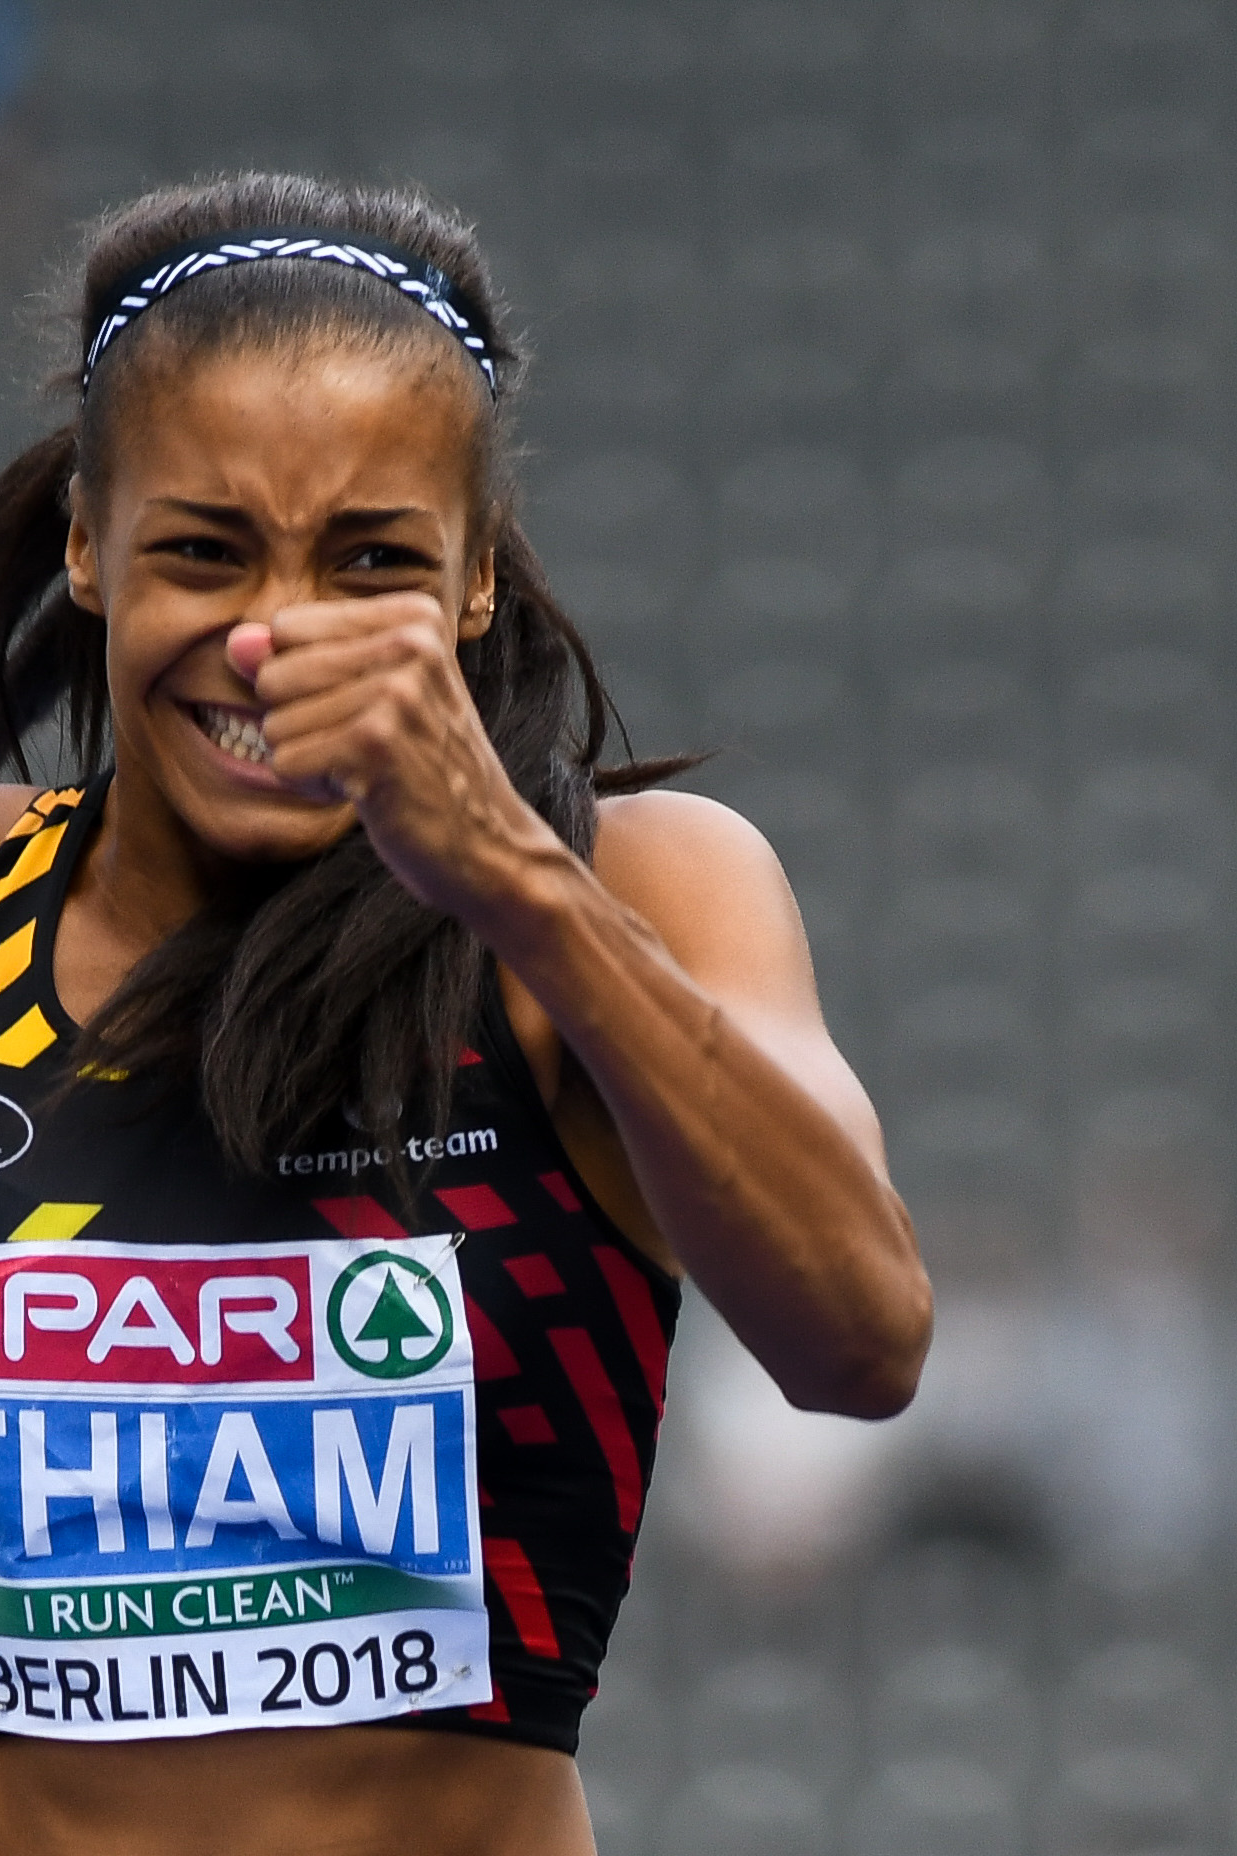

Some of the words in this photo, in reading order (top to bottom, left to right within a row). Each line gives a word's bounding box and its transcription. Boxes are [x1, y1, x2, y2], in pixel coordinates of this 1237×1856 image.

[23, 1594, 35, 1633] I
[50, 1588, 155, 1634] RUN
[256, 1629, 438, 1713] 2018
